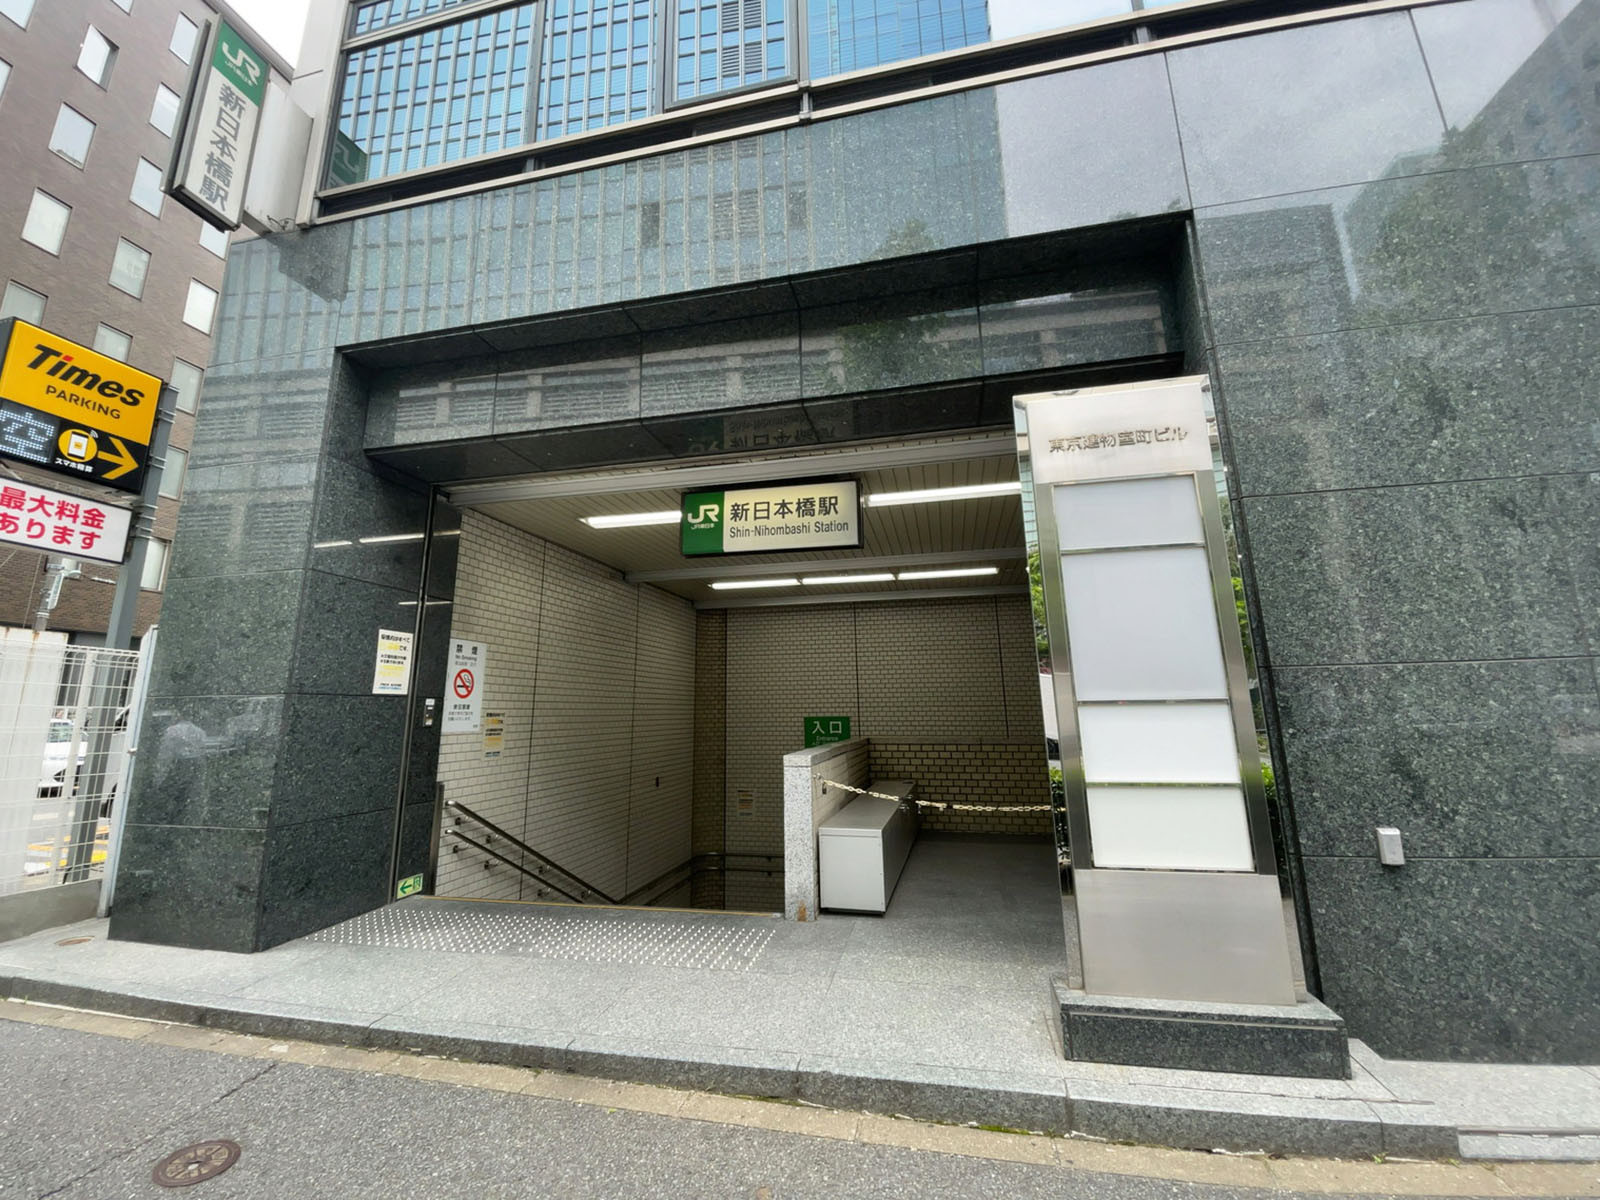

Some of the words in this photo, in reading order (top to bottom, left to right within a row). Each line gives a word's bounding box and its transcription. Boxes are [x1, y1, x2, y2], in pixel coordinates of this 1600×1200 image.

[222, 41, 261, 86] JR
[200, 83, 246, 211] 新日本橋駅
[27, 343, 145, 407] Times
[46, 384, 121, 420] PARKING
[1048, 426, 1188, 453] 東京建物室町ビル
[0, 486, 107, 530] 最大料金
[687, 503, 720, 523] JR
[730, 495, 839, 522] 新日本橋駅
[0, 512, 102, 550] あります
[729, 521, 811, 539] Shin-Nihombashi
[814, 519, 849, 533] Station
[812, 720, 842, 734] 入口
